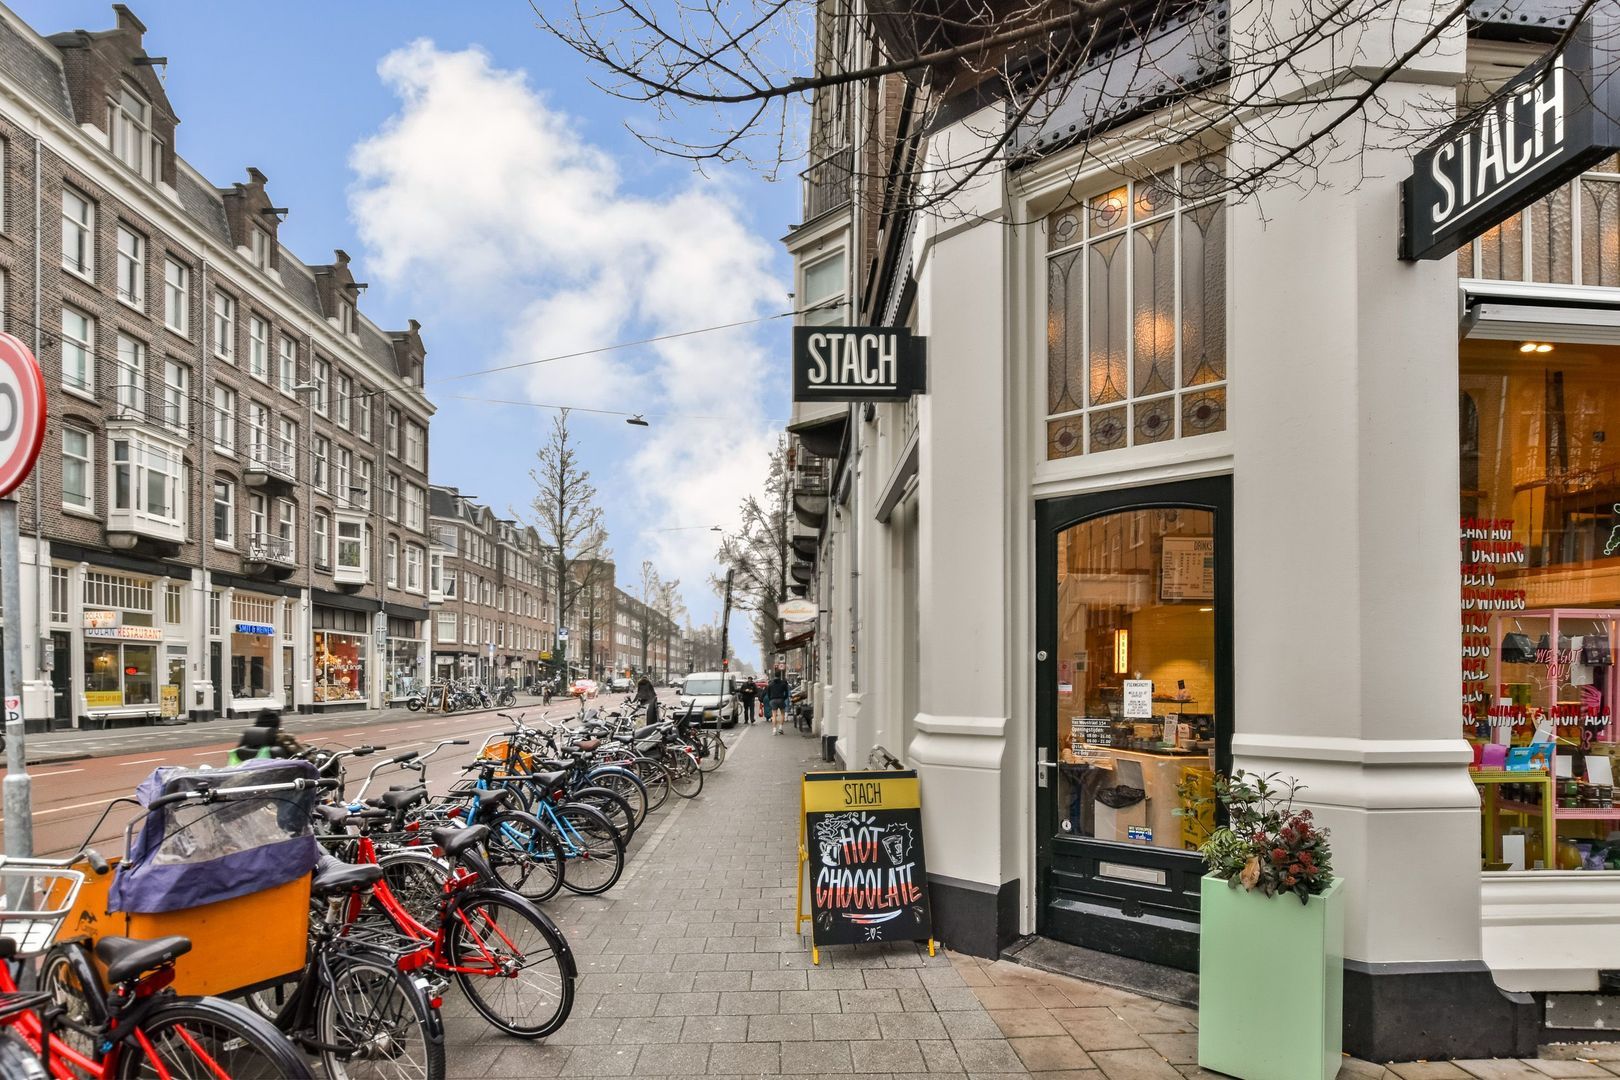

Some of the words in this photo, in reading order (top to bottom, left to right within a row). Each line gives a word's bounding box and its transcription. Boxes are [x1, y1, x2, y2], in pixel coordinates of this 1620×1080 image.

[1432, 53, 1565, 223] STACH
[808, 333, 897, 384] STACH
[88, 628, 115, 636] DOLAN
[117, 628, 162, 639] RESTAURANT
[1535, 649, 1554, 663] WE
[844, 782, 882, 804] STACH
[839, 826, 885, 865] HOT
[815, 862, 923, 909] CHOCOLATE
